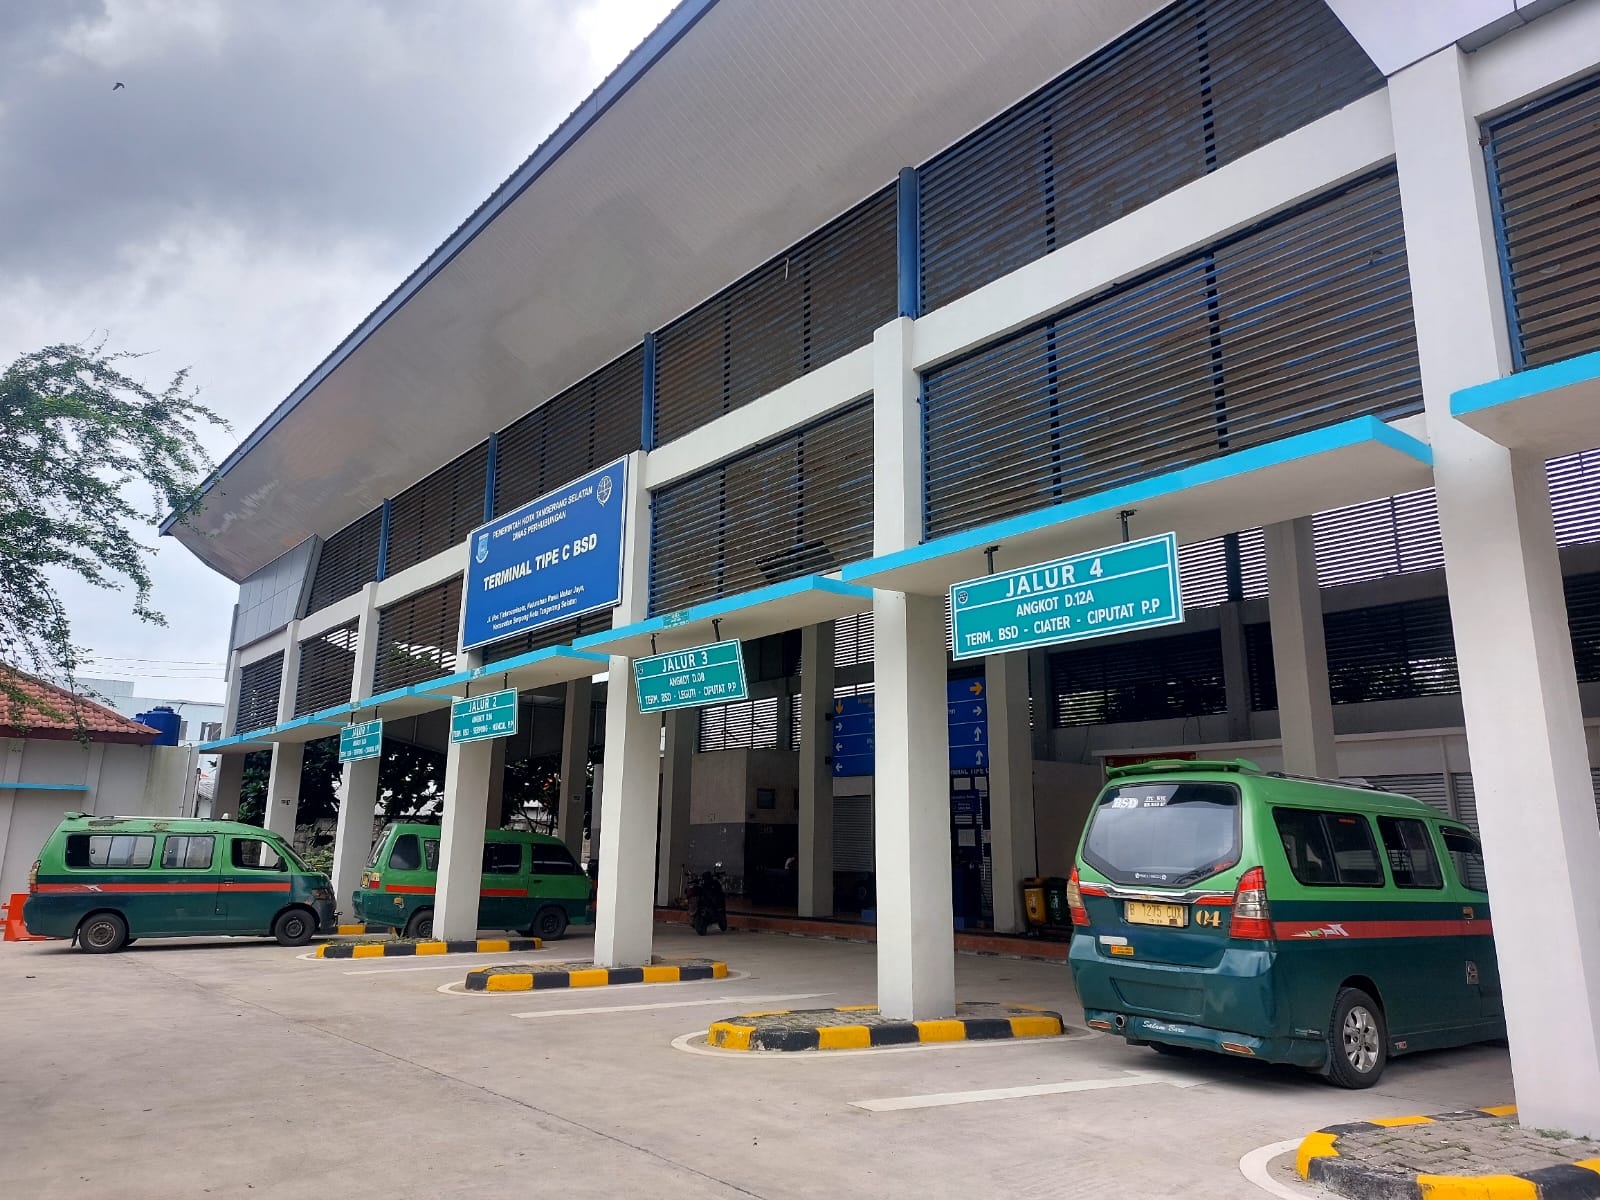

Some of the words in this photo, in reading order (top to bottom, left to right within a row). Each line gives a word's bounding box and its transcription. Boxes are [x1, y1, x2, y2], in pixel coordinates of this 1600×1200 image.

[522, 514, 535, 526] KOTA
[536, 498, 567, 519] TANGERANG
[567, 486, 593, 504] SELATAN
[512, 528, 527, 541] DINAS
[527, 510, 567, 534] PERHUBUNGAN
[483, 560, 532, 592] TERMINAL
[535, 548, 560, 571] TIPE
[562, 544, 570, 561] C
[573, 533, 597, 556] BSD
[1006, 565, 1075, 597] JALUR
[1089, 558, 1104, 578] 4
[1016, 597, 1059, 617] ANGKOT
[1064, 590, 1095, 608] D.12A
[965, 630, 994, 646] TERM.
[998, 625, 1018, 641] BSD
[1033, 616, 1070, 634] CIATER
[1087, 603, 1135, 624] CIPUTAT
[1141, 598, 1160, 615] P.P
[662, 653, 696, 672] JALUR
[701, 651, 708, 664] 3
[661, 692, 672, 702] BSD
[703, 683, 725, 696] CIPUTAT
[669, 674, 690, 687] ANGKOT
[469, 698, 490, 713] JALUR
[492, 696, 497, 708] 2
[1130, 904, 1135, 915] B
[1142, 904, 1162, 917] 1275
[1195, 910, 1222, 927] 04
